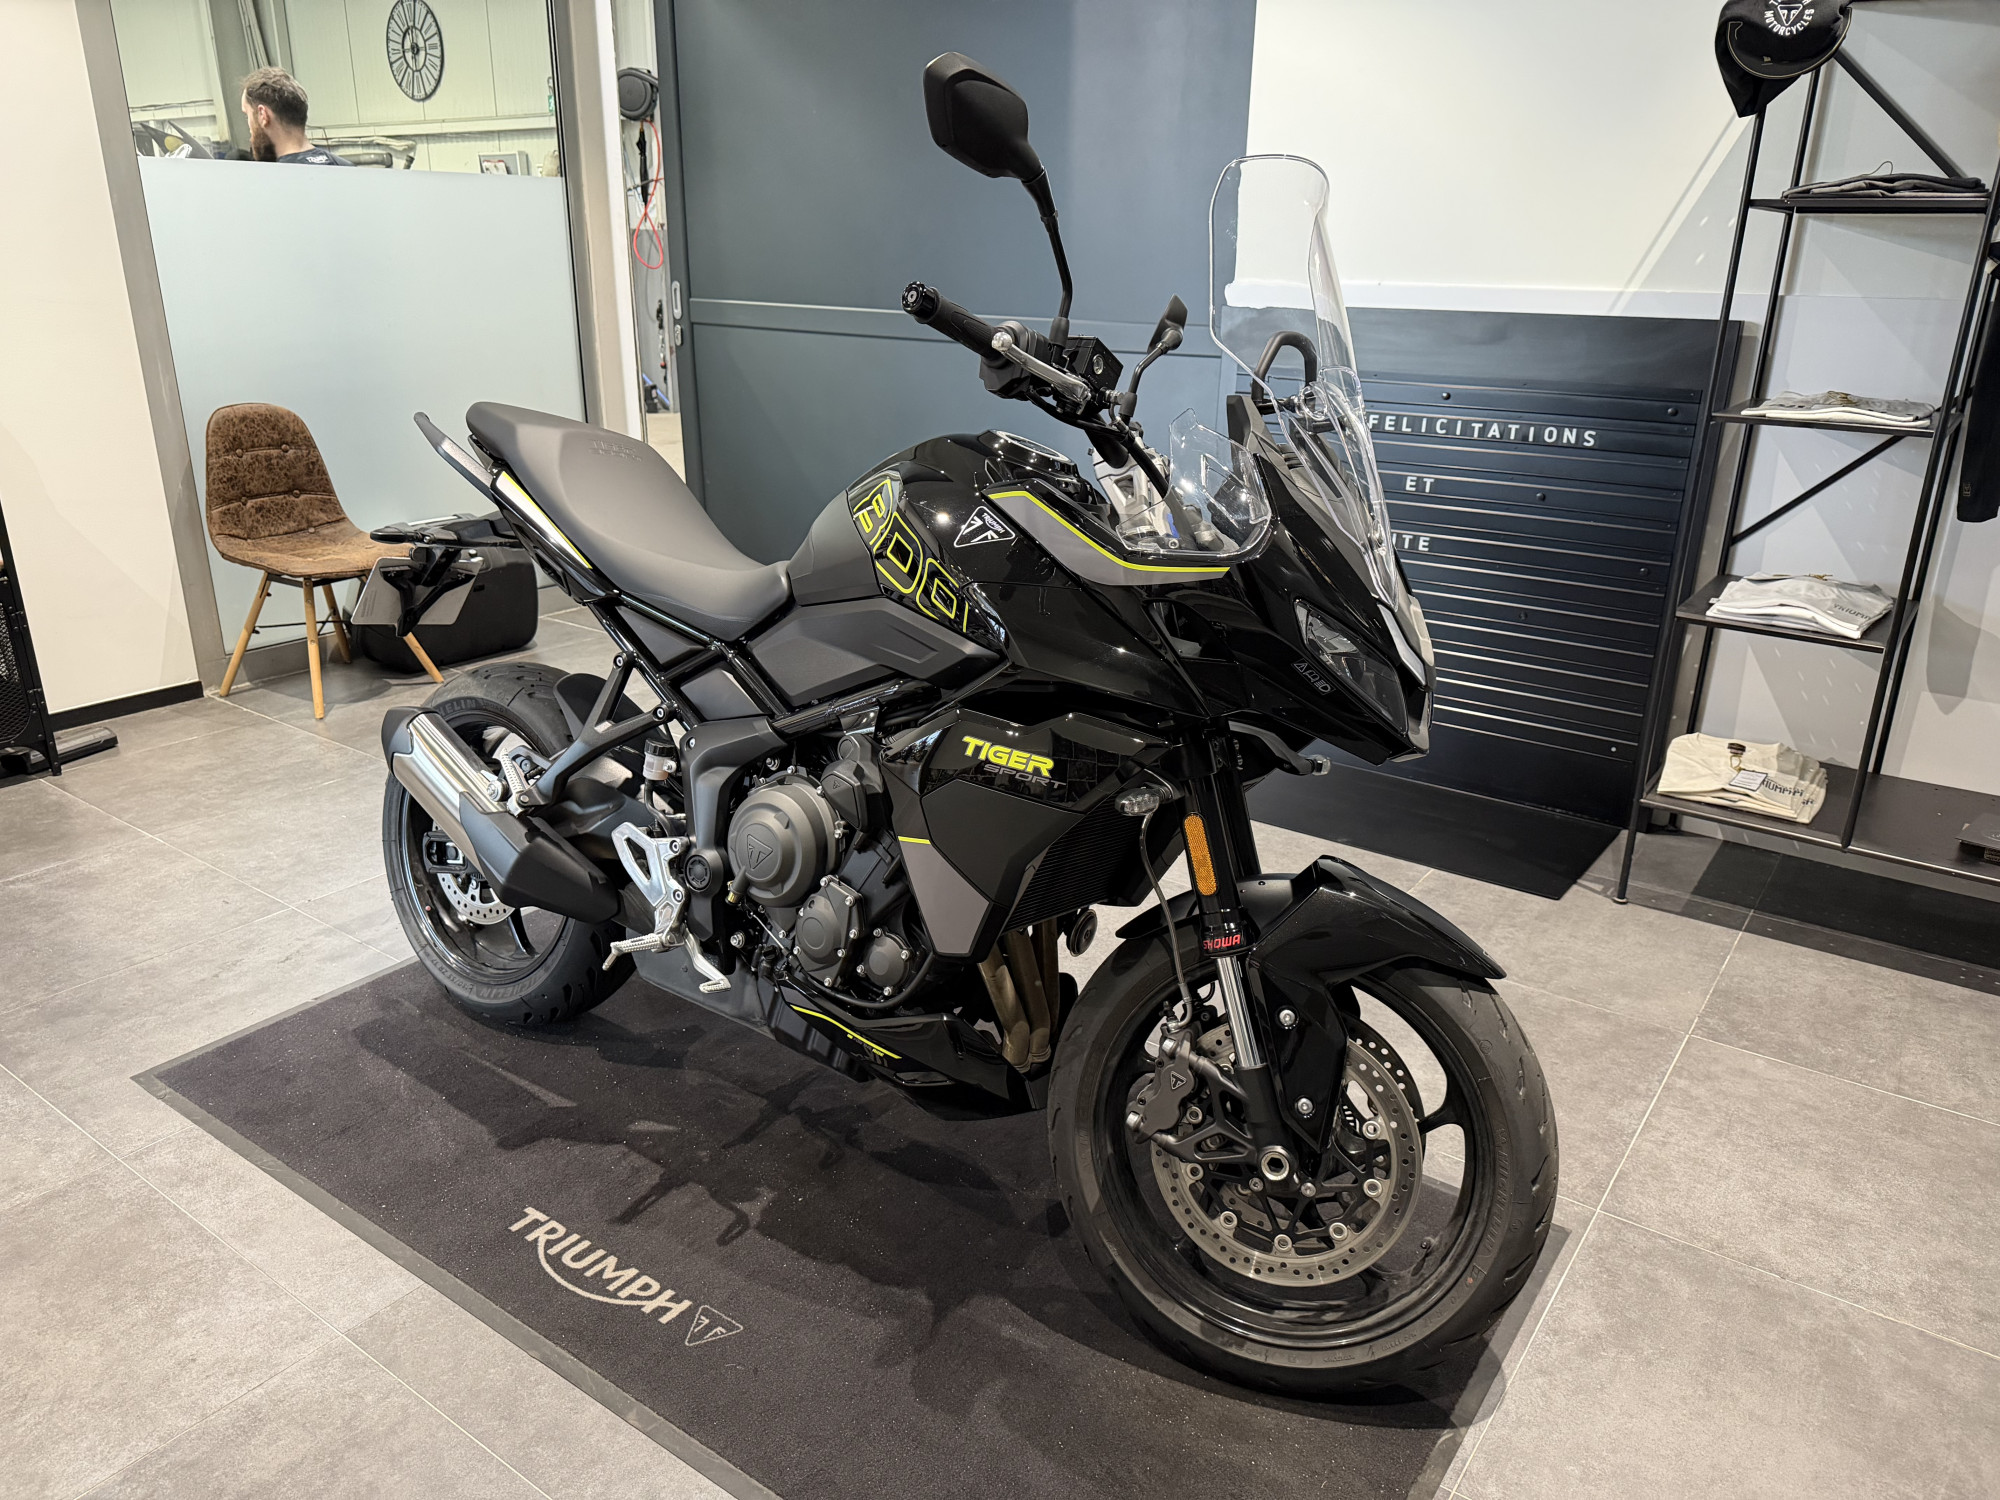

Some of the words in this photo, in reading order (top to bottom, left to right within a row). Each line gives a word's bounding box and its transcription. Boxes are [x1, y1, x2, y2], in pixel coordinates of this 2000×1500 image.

[1764, 8, 1815, 36] MOTORCYCLES
[1368, 414, 1597, 447] FELICITATIONS
[1405, 476, 1435, 493] ET
[962, 736, 1054, 778] TIGER
[984, 763, 1067, 789] SPORT
[1203, 934, 1241, 950] SHOWA
[507, 1206, 693, 1324] TRIUMPH
